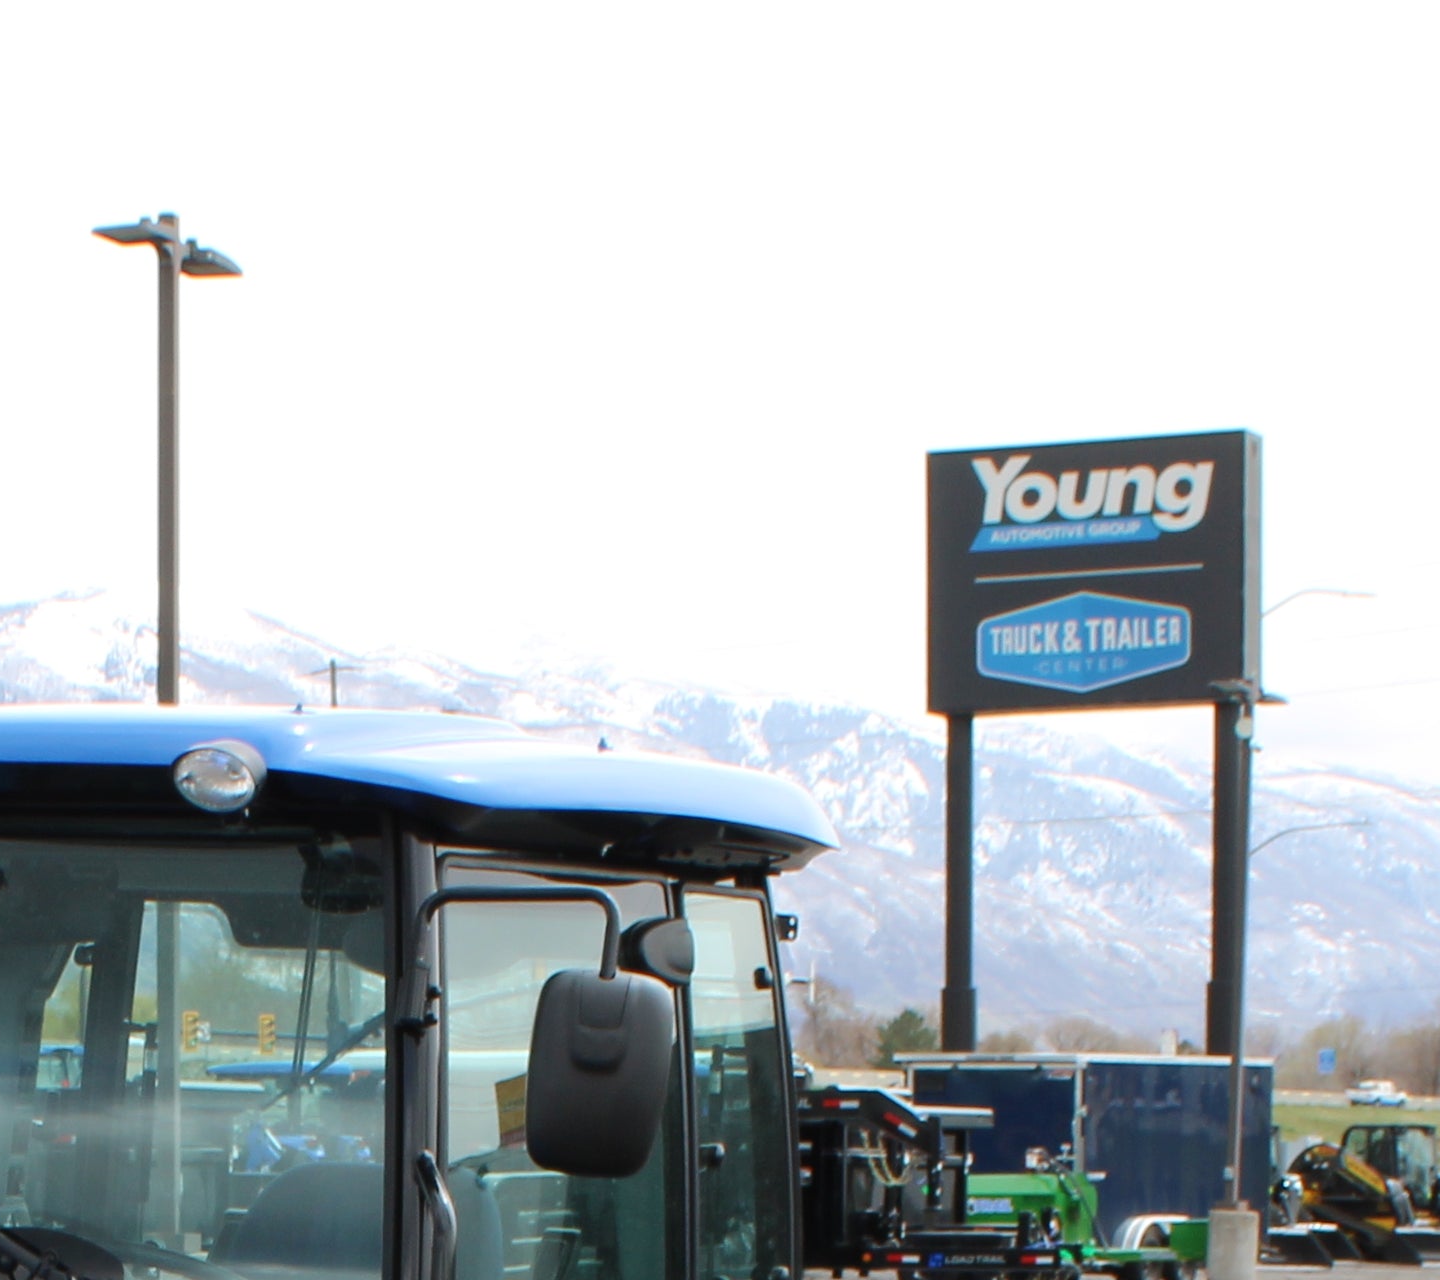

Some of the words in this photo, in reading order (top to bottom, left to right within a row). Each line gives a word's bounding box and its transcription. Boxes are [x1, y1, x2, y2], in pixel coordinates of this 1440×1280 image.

[971, 454, 1215, 532] Young
[991, 523, 1085, 544] AUTOMOTIVE
[1088, 520, 1143, 537] GROUP
[990, 621, 1060, 655] TRUCK
[1062, 618, 1082, 654] &
[1085, 616, 1182, 652] TRAILER
[1038, 656, 1125, 675] CENTER
